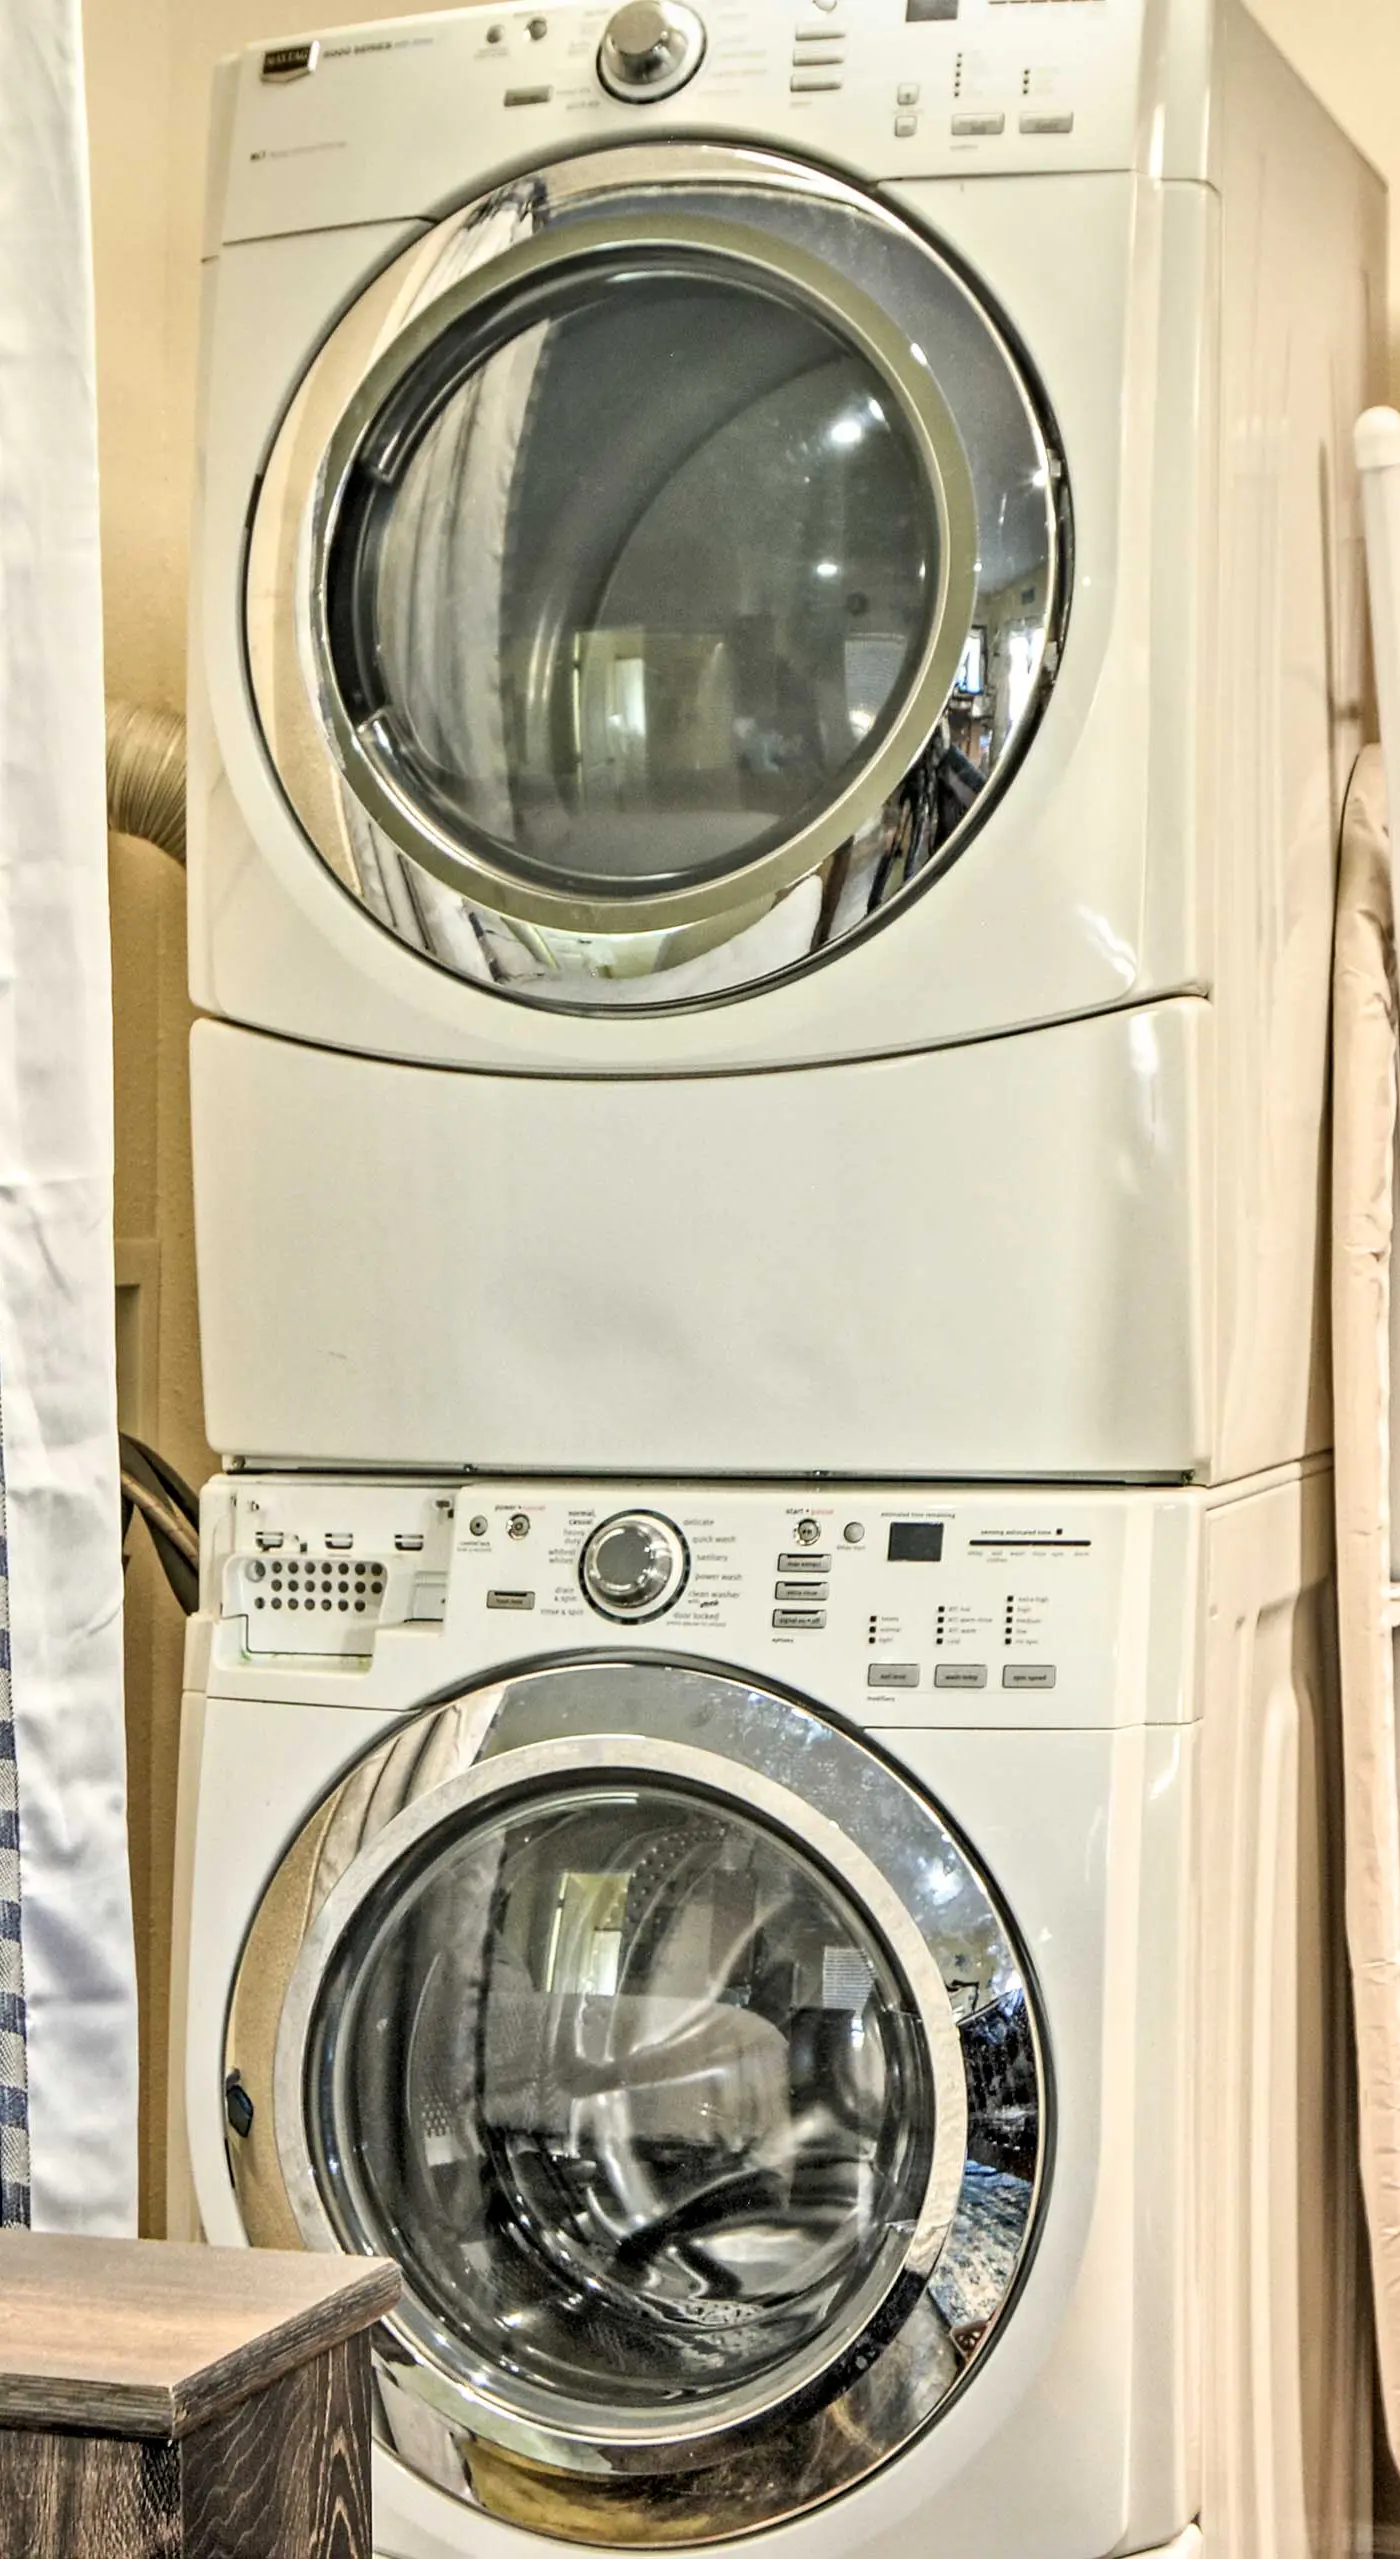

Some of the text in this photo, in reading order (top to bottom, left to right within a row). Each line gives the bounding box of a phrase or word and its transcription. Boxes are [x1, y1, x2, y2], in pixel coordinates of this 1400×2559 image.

[267, 50, 308, 65] MAYTAG
[692, 1536, 713, 1544] quick
[693, 1612, 720, 1620] locked
